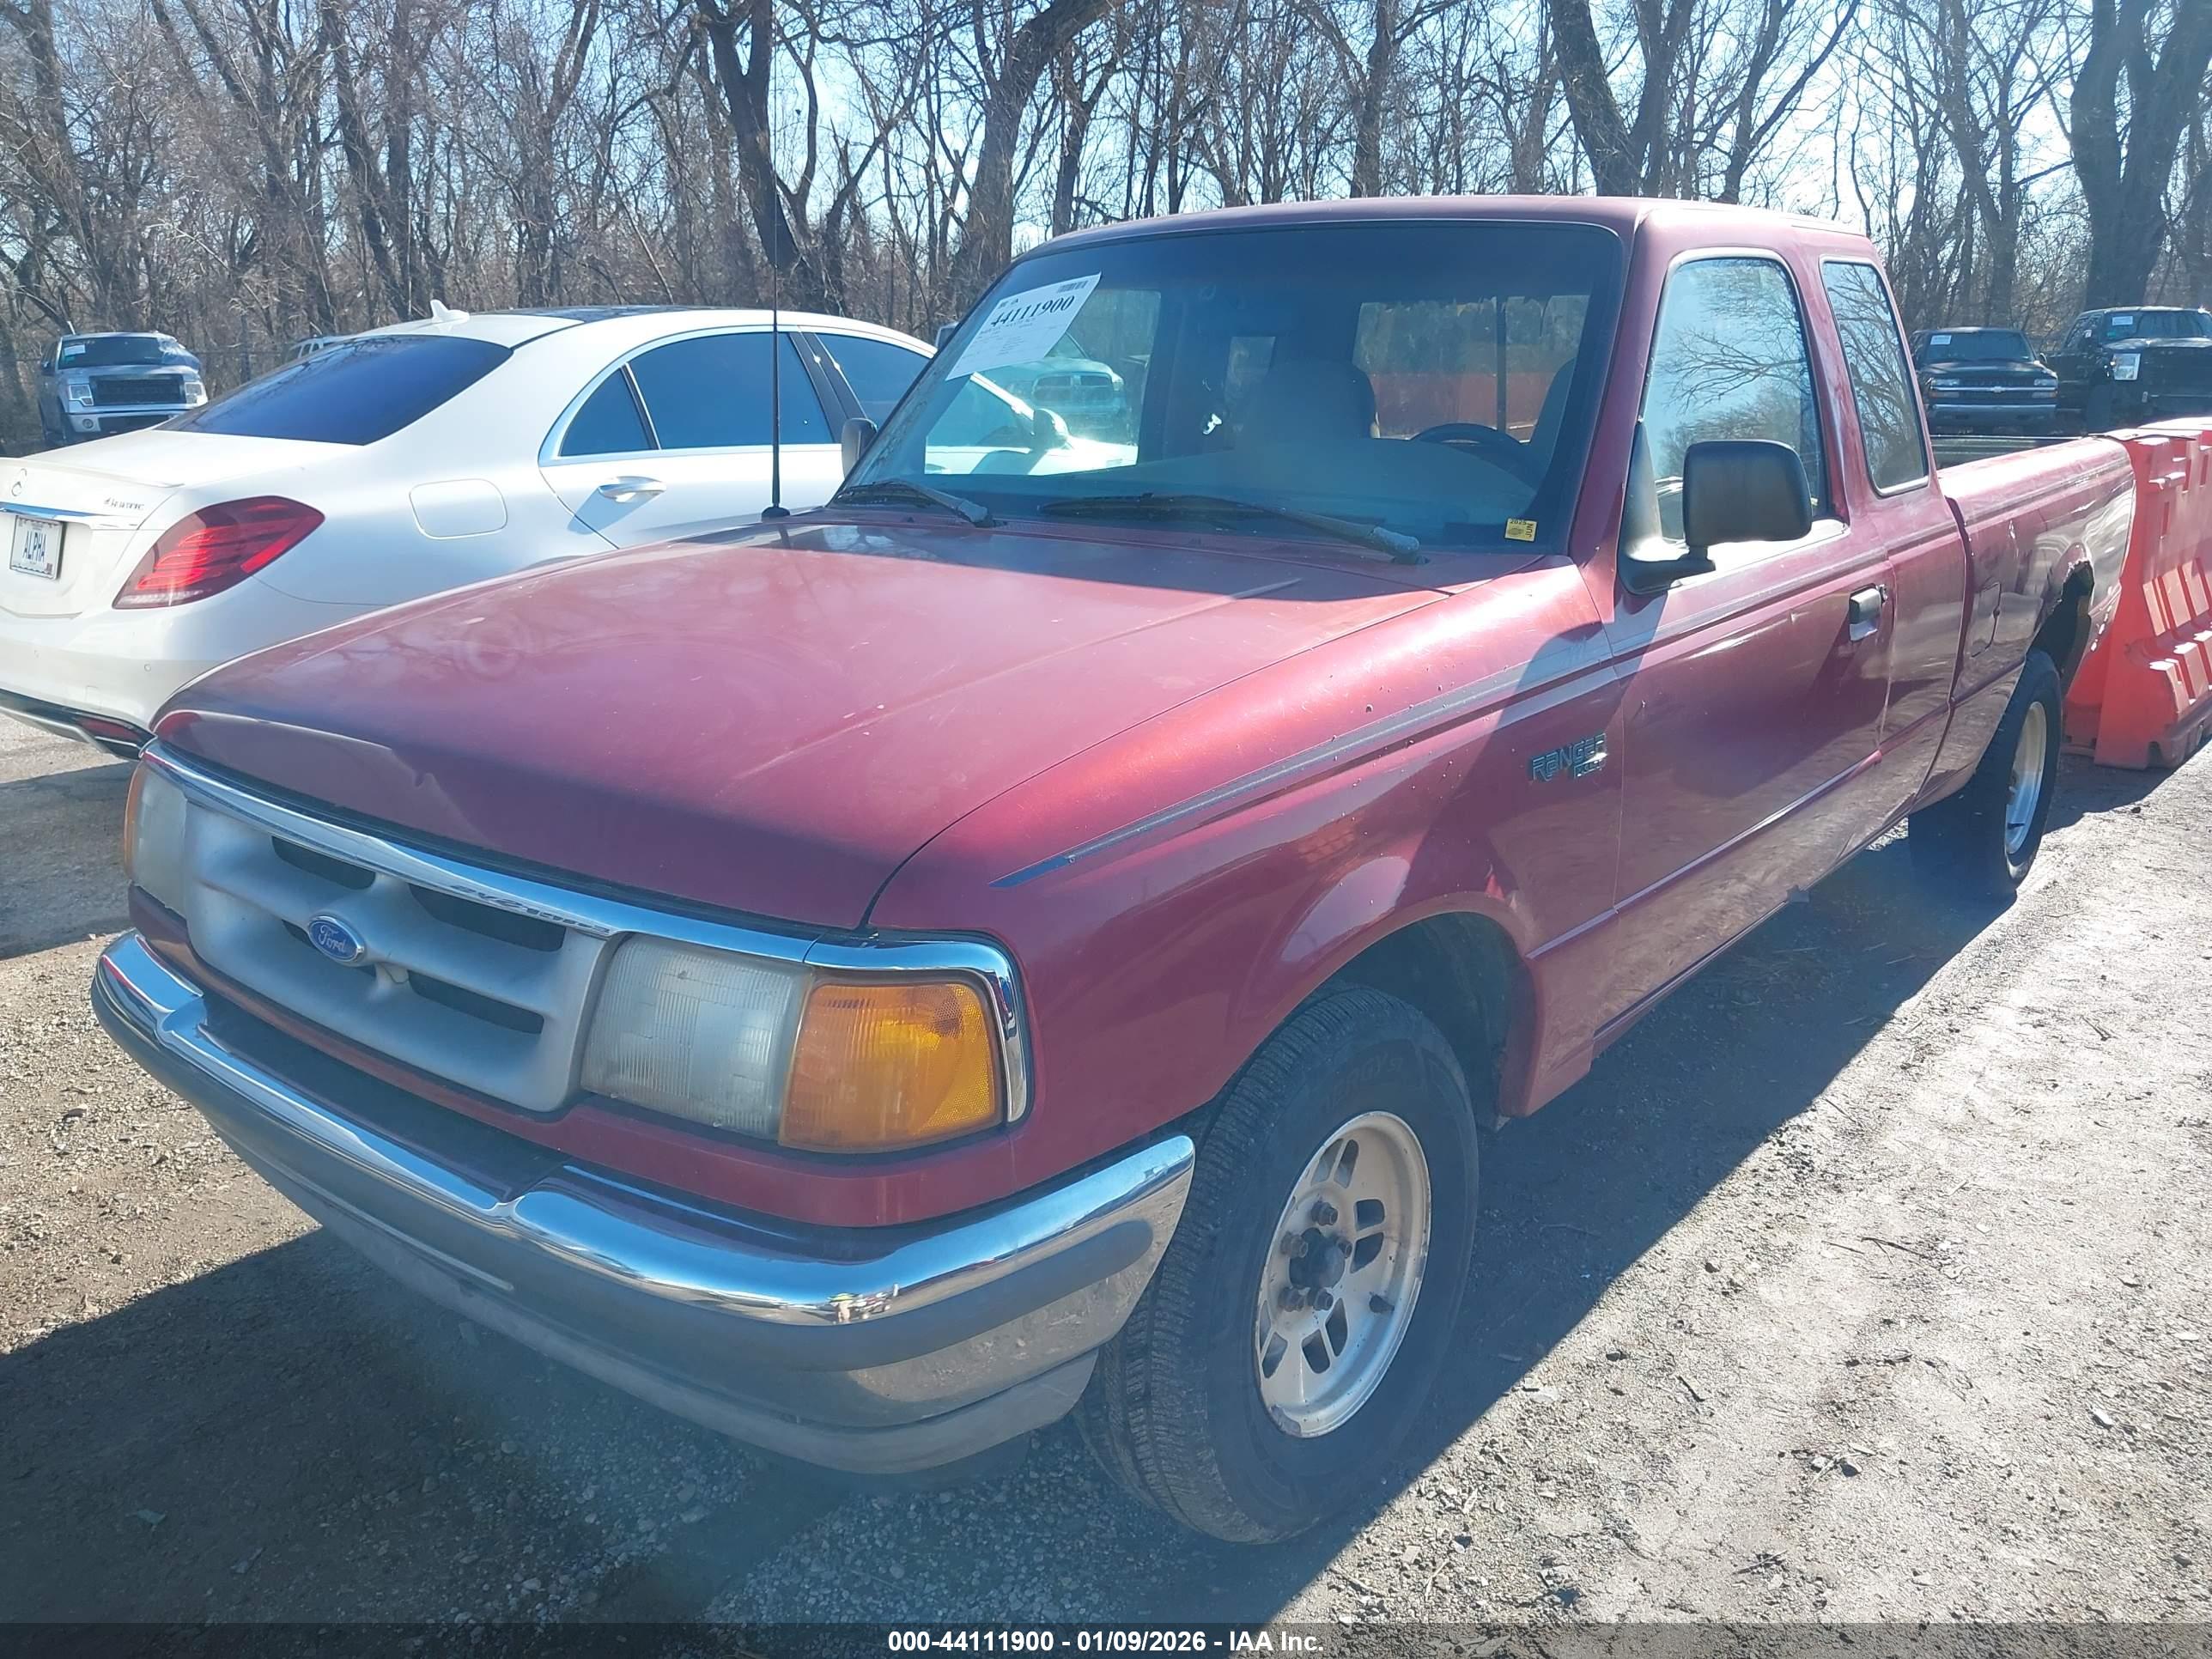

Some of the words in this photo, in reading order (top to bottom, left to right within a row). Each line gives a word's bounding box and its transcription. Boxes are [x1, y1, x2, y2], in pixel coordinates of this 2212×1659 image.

[991, 295, 1075, 327] 44111900
[22, 530, 47, 562] ALPHA
[1525, 523, 1534, 538] JUN
[1532, 732, 1607, 782] RANGER
[318, 924, 347, 954] Ford
